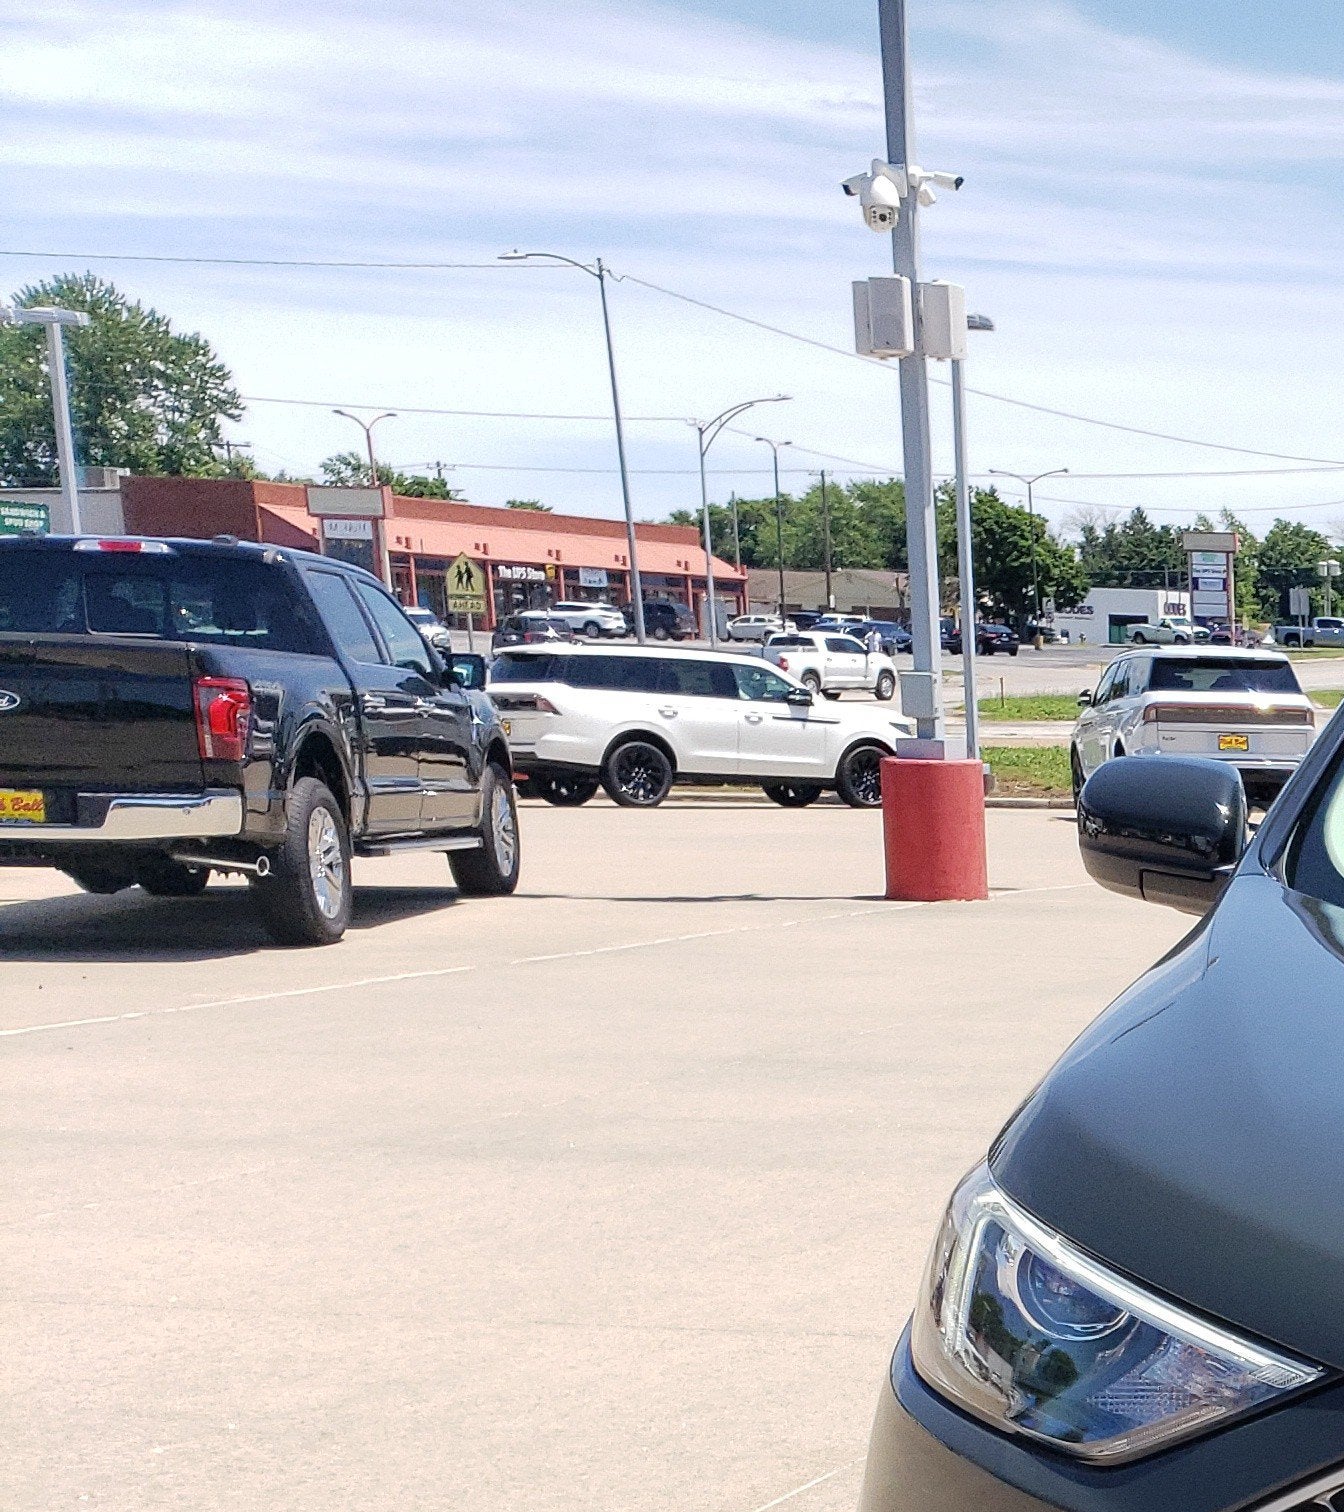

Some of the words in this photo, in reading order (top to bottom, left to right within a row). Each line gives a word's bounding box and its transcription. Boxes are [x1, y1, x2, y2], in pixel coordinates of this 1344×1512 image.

[498, 565, 512, 579] The
[513, 566, 527, 580] UPS
[453, 601, 482, 611] AHEAD
